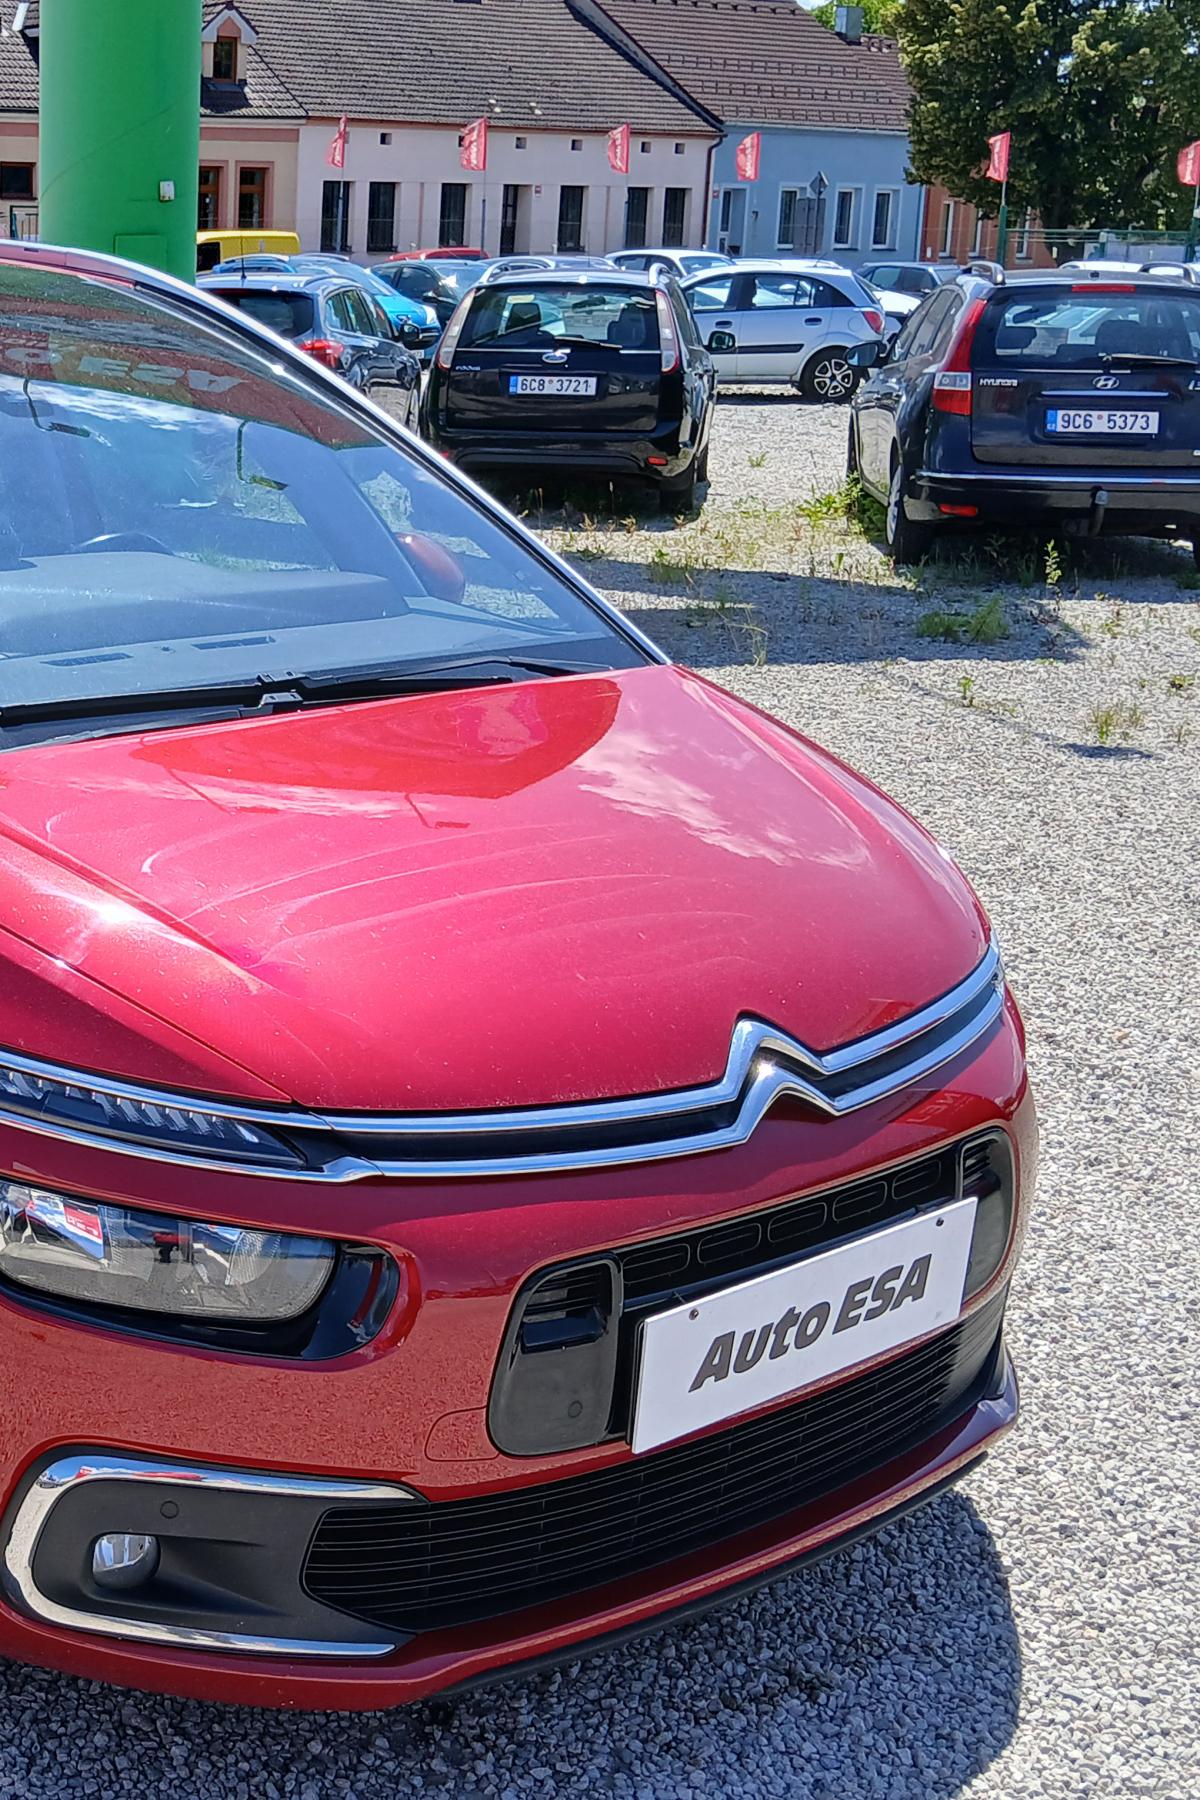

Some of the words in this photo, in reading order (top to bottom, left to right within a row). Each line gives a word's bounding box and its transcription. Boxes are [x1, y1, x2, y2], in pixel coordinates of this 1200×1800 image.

[520, 375, 545, 392] 6C8
[556, 376, 589, 393] 3721
[1061, 413, 1093, 429] 9C6
[1107, 414, 1150, 430] 5373
[832, 1253, 932, 1335] ESA
